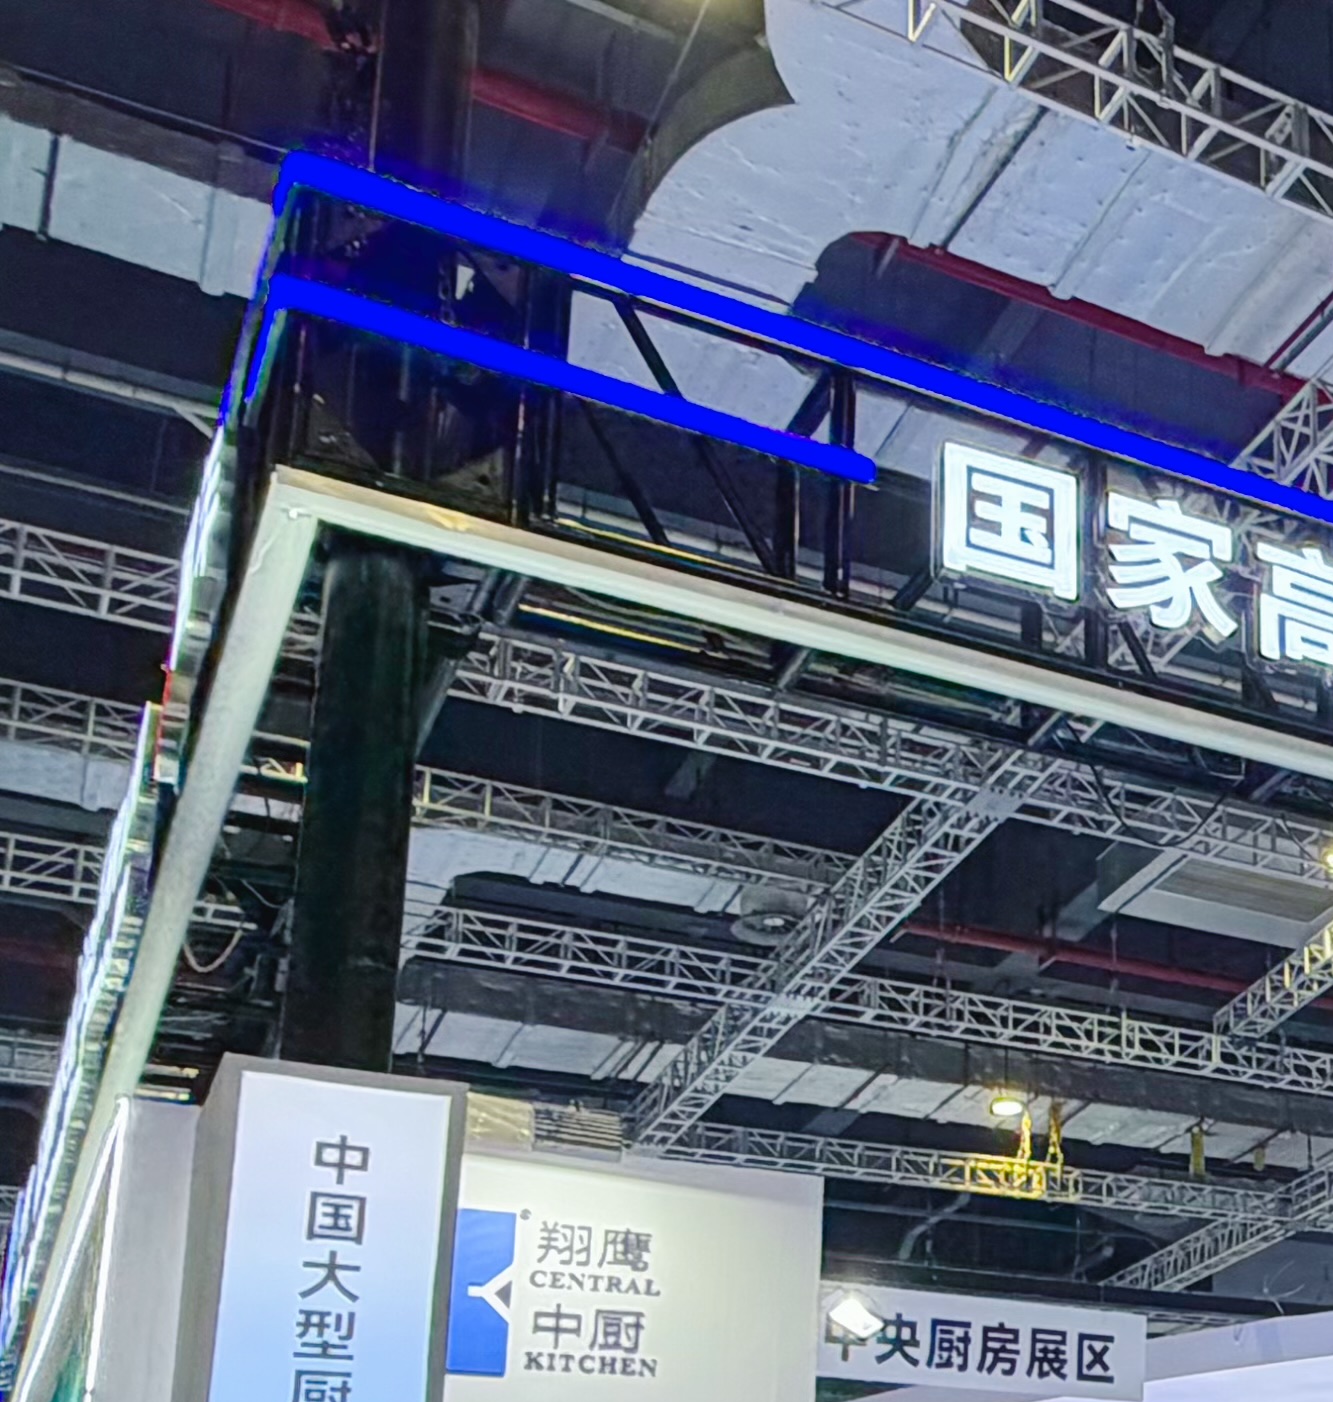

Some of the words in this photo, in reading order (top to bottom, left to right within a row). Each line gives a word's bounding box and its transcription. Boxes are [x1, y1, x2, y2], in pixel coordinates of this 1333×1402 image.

[537, 1220, 653, 1272] 翔鹰
[529, 1269, 661, 1297] CENTRAL
[532, 1303, 646, 1355] 中厨
[523, 1351, 658, 1378] KITCHEN
